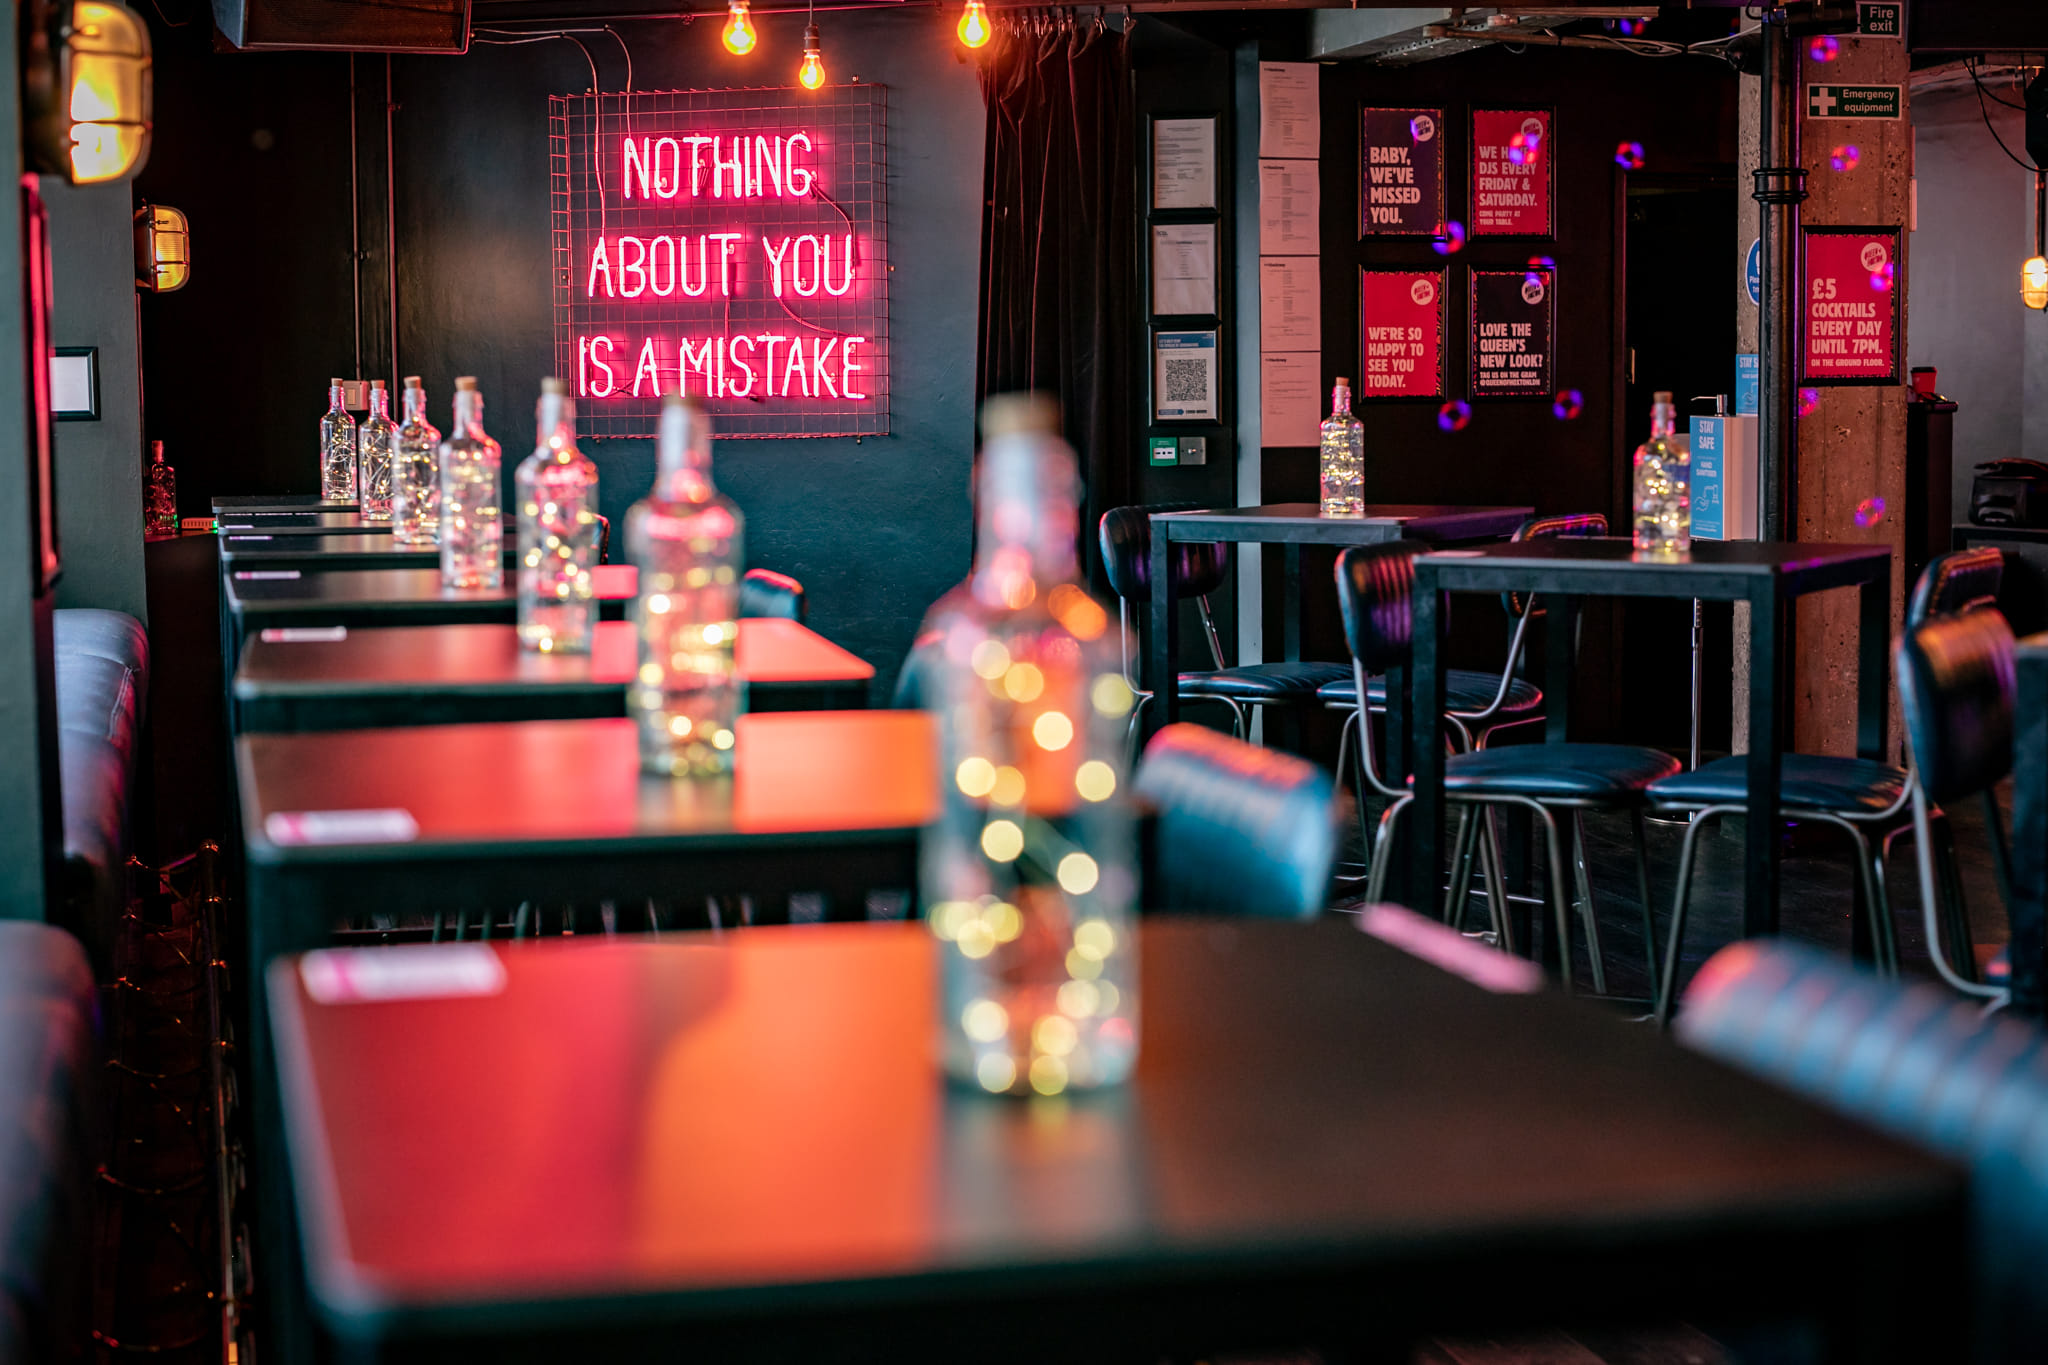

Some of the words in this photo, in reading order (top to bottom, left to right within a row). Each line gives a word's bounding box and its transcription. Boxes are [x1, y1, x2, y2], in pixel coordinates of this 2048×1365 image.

[1870, 6, 1894, 18] Fire
[1870, 20, 1893, 31] exit
[1842, 89, 1894, 100] Emergency
[1844, 102, 1893, 113] equipment
[1370, 147, 1411, 165] BABY,
[1479, 146, 1497, 159] WE
[624, 134, 812, 199] NOTHING
[1479, 162, 1498, 175] DJS
[1502, 162, 1536, 175] EVERY
[1370, 167, 1414, 184] WE'VE
[1479, 177, 1518, 190] FRIDAY
[1522, 178, 1530, 190] &
[1370, 187, 1421, 204] MISSED
[1479, 193, 1537, 206] SATURDAY.
[1370, 207, 1403, 224] YOU.
[588, 233, 741, 297] ABOUT
[762, 234, 853, 297] YOU
[1812, 278, 1837, 299] £5
[1812, 303, 1876, 318] COCKTAILS
[1368, 327, 1404, 340] WE'RE
[1408, 327, 1422, 340] SO
[1480, 323, 1507, 336] LOVE
[1511, 323, 1532, 336] THE
[1812, 321, 1852, 336] EVERY
[1857, 321, 1882, 336] DAY
[1368, 343, 1406, 356] HAPPY
[1410, 343, 1424, 356] TO
[1480, 339, 1526, 352] QUEEN'S
[1812, 339, 1848, 354] UNTIL
[1852, 339, 1883, 354] 7PM.
[578, 336, 614, 398] IS
[632, 337, 661, 398] A
[680, 335, 865, 399] MISTAKE
[1368, 359, 1388, 372] SEE
[1392, 359, 1414, 372] YOU
[1480, 354, 1506, 368] NEW
[1510, 354, 1543, 368] LOOK?
[1740, 357, 1752, 368] STAY
[1368, 375, 1406, 388] TODAY.
[1699, 421, 1714, 434] STAY
[1699, 436, 1715, 450] SAFE
